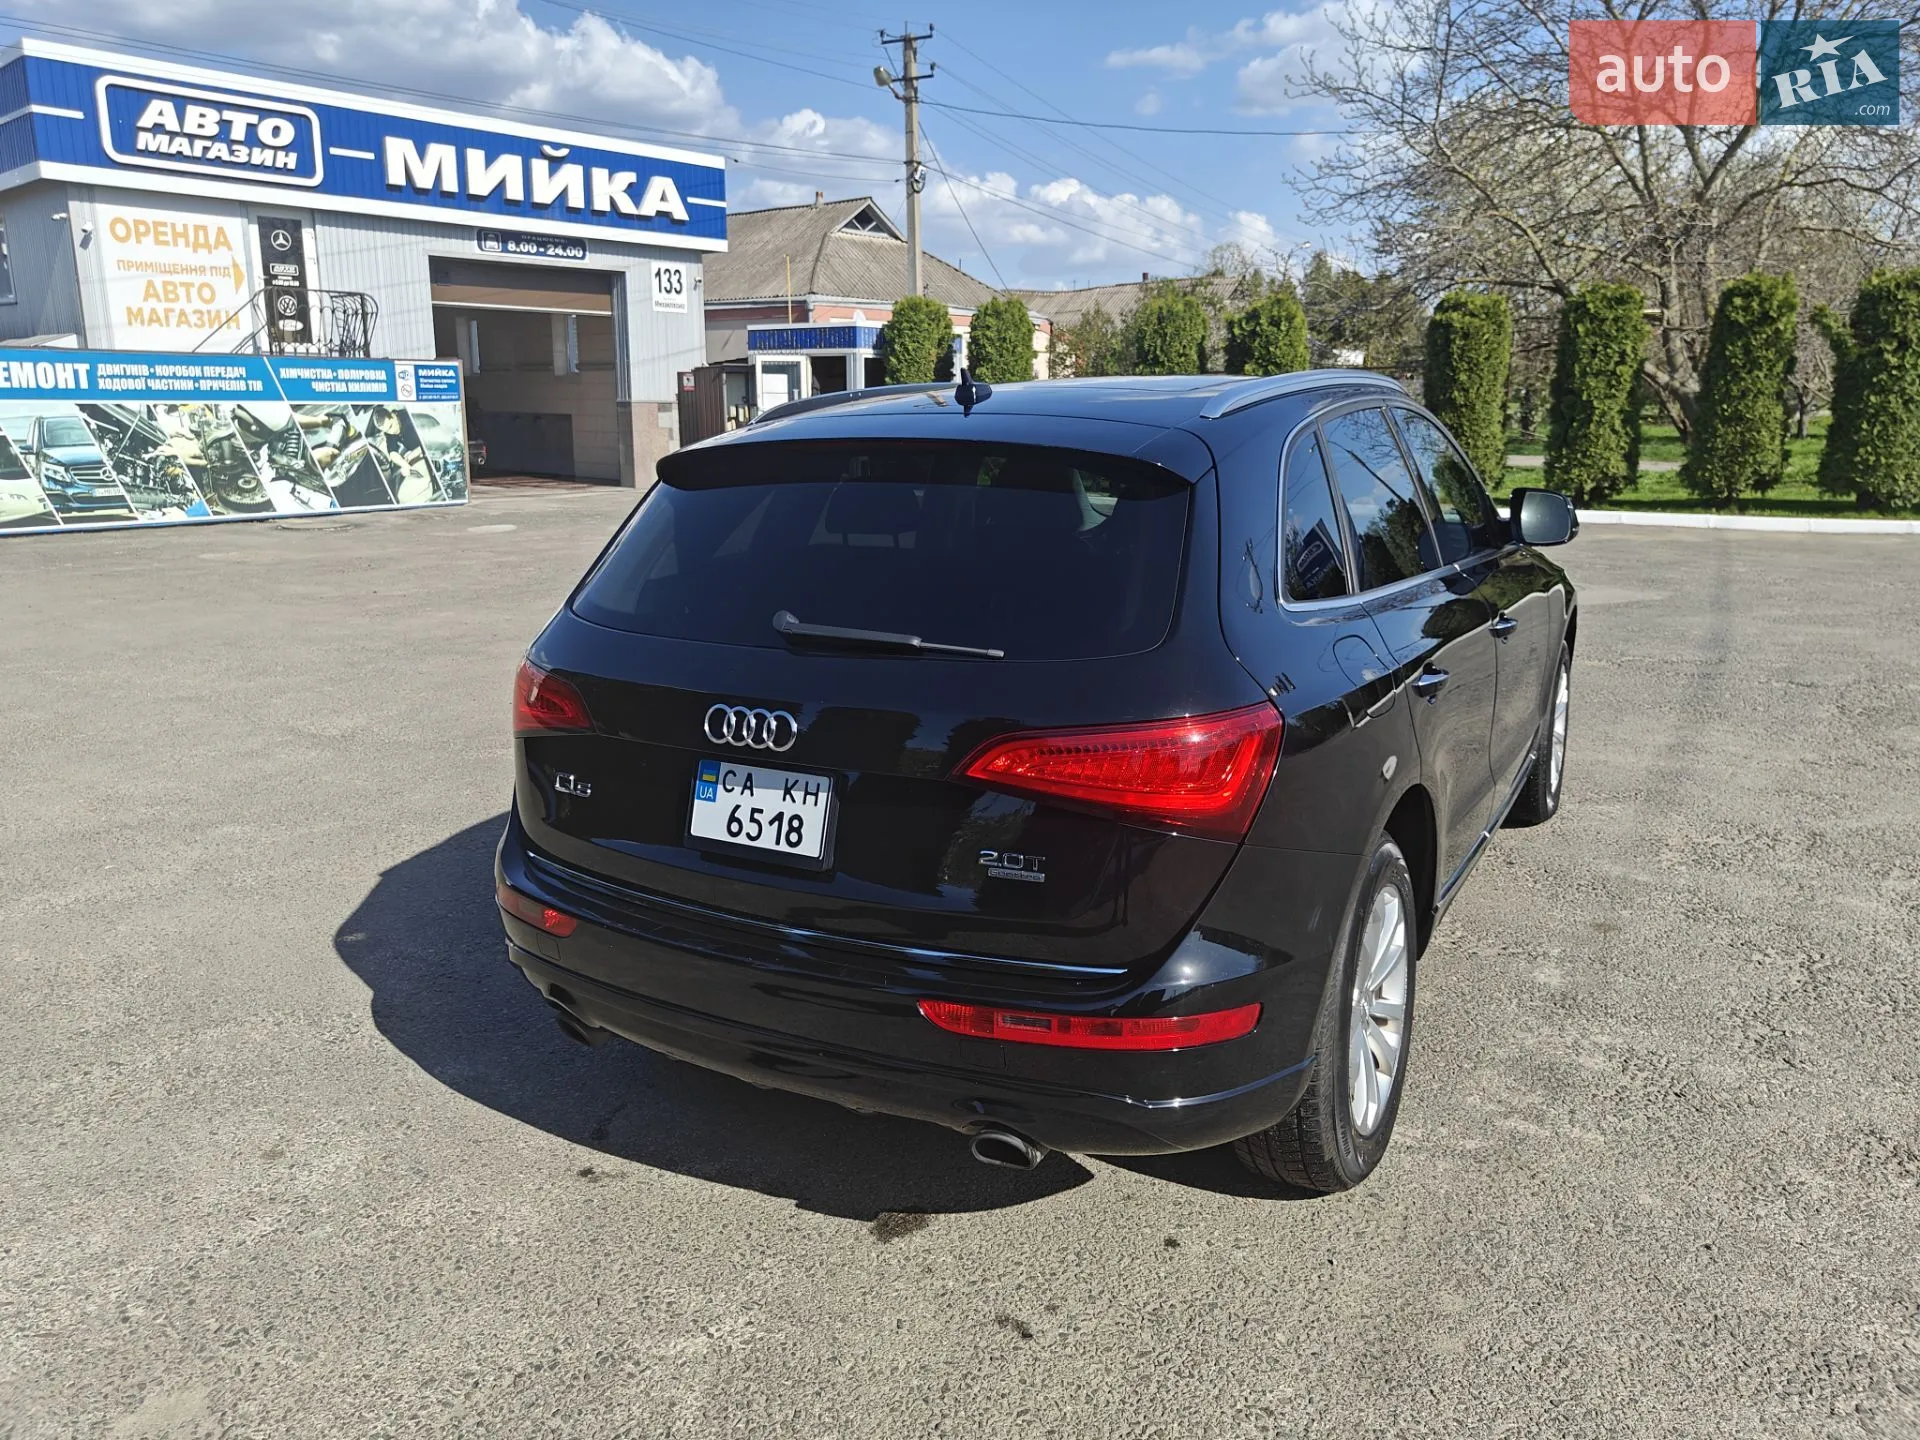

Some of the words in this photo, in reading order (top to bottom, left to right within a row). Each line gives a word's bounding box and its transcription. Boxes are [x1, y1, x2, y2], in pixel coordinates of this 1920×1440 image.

[137, 99, 296, 148] АВТО
[136, 132, 298, 171] МАГАЗИН
[383, 135, 690, 222] МИЙКА
[109, 217, 233, 254] ОРЕНДА
[117, 261, 207, 277] ПРИМІЩЕННЯ
[209, 264, 231, 278] ПІД
[655, 267, 683, 295] 133
[143, 280, 216, 305] АВТО
[126, 307, 240, 331] МАГАЗИН
[0, 361, 91, 390] ЕМОНТ
[97, 363, 149, 377] ДВИГУНІВ
[155, 364, 202, 377] КОРОБОК
[203, 366, 246, 378] ПЕРЕДАЧ
[279, 368, 333, 380] ХІМЧИСТКА
[337, 369, 387, 381] ПОЛІРОВКА
[418, 368, 456, 377] МИЙКА
[98, 377, 146, 391] ХОДОВОЇ
[148, 379, 194, 391] ЧАСТИНИ
[200, 380, 246, 391] ПРИЧЕПІВ
[311, 381, 347, 393] ЧИСТКА
[348, 382, 387, 393] КИЛИМІВ
[699, 787, 714, 800] UA
[722, 769, 754, 797] CA
[783, 778, 820, 807] KH
[726, 804, 804, 849] 6518
[979, 850, 1046, 872] 2.0T
